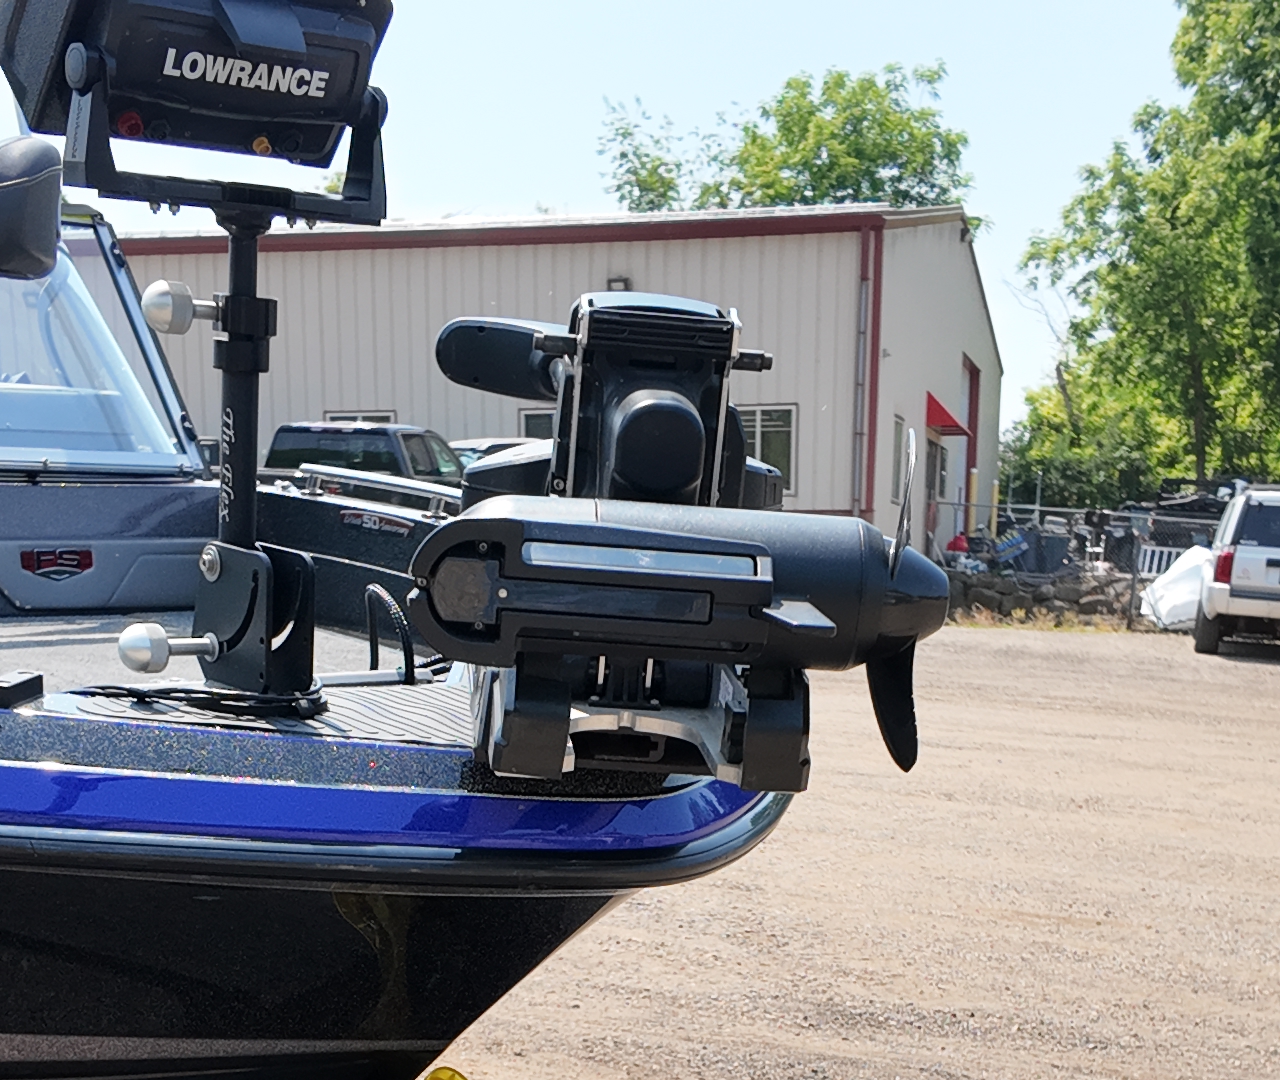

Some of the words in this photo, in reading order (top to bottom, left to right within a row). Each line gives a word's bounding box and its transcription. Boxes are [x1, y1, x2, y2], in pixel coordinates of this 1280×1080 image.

[163, 47, 329, 98] LOWRANCE
[222, 407, 235, 456] The
[219, 463, 235, 523] Flex
[362, 514, 380, 530] 50
